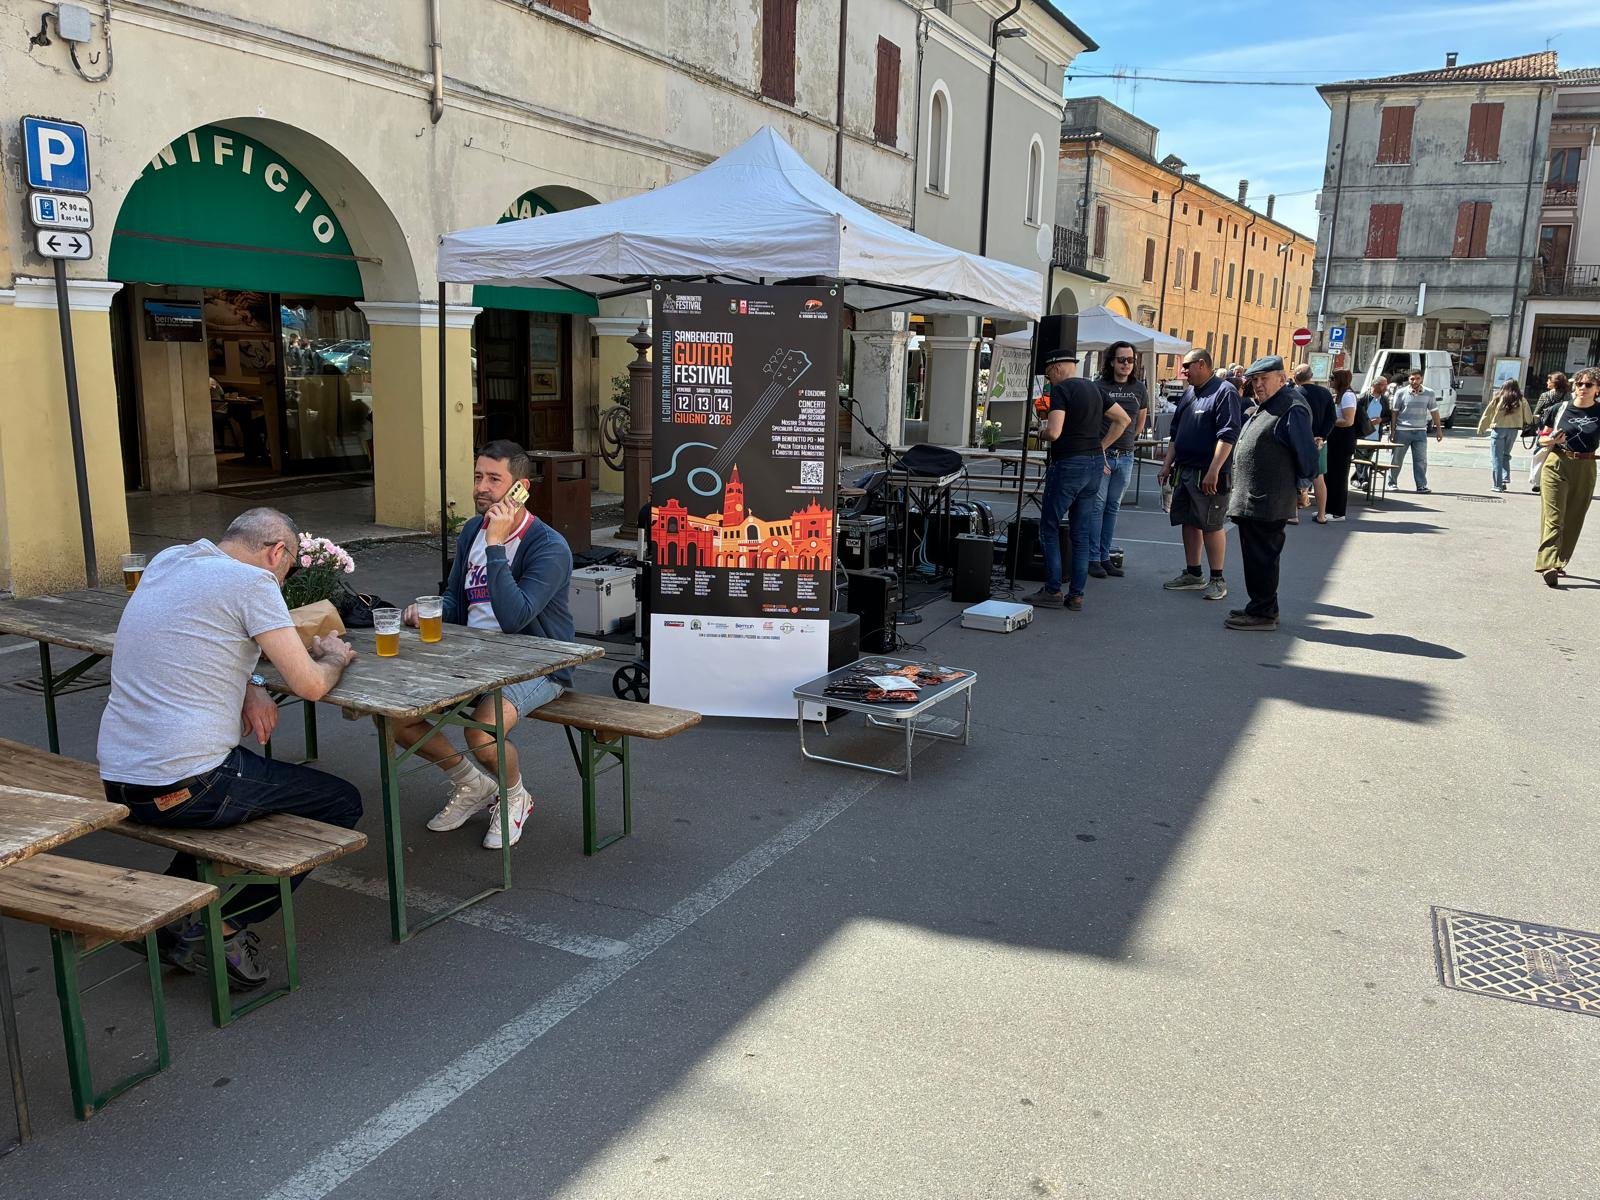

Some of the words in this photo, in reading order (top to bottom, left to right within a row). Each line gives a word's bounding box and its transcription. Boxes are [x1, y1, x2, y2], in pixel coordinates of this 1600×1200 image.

[37, 127, 75, 182] P
[137, 132, 335, 243] NIFICIO
[675, 301, 701, 310] FESTIVAL
[1337, 296, 1412, 305] TABACCHI
[662, 330, 671, 354] PIAZZA
[675, 331, 733, 344] SANBENEDETTO
[1332, 328, 1342, 340] P
[675, 343, 733, 366] GUITAR
[662, 365, 671, 387] TORNA
[675, 365, 732, 385] FESTIVAL
[662, 389, 671, 414] GUITAR
[678, 396, 689, 410] 12
[698, 397, 709, 410] 13
[717, 398, 729, 411] 14
[798, 400, 826, 408] CONCERTI
[675, 413, 707, 424] GIUGNO
[709, 414, 732, 425] 2026
